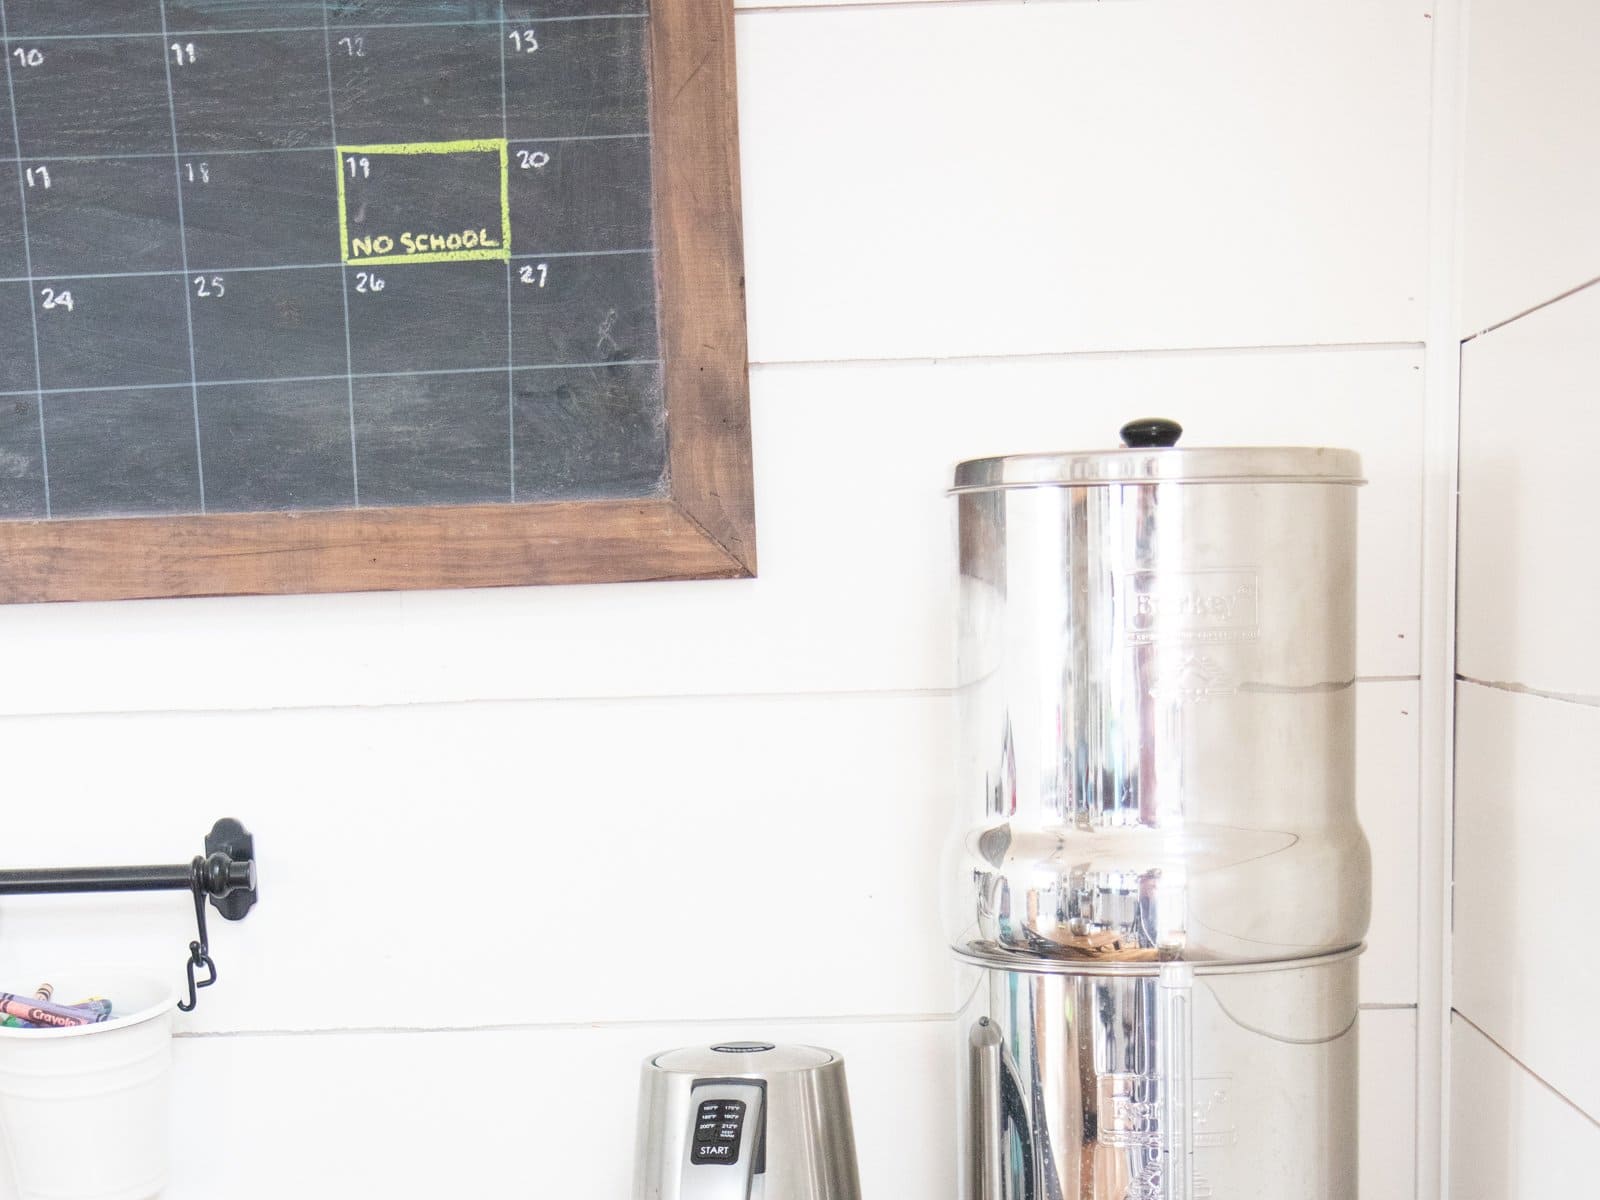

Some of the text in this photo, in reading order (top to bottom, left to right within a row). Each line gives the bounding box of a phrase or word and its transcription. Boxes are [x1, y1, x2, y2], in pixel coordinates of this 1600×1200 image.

[338, 36, 365, 57] 12
[509, 29, 538, 53] 13
[13, 47, 44, 67] 10
[171, 43, 197, 66] 11
[347, 156, 370, 178] 19
[516, 150, 550, 169] 20
[26, 165, 51, 189] 17
[185, 162, 210, 184] 18
[352, 228, 500, 256] NO SCHOOL
[355, 272, 385, 293] 26
[518, 263, 548, 288] 27
[194, 276, 226, 298] 25
[41, 287, 75, 311] 24
[700, 1146, 729, 1155] START
